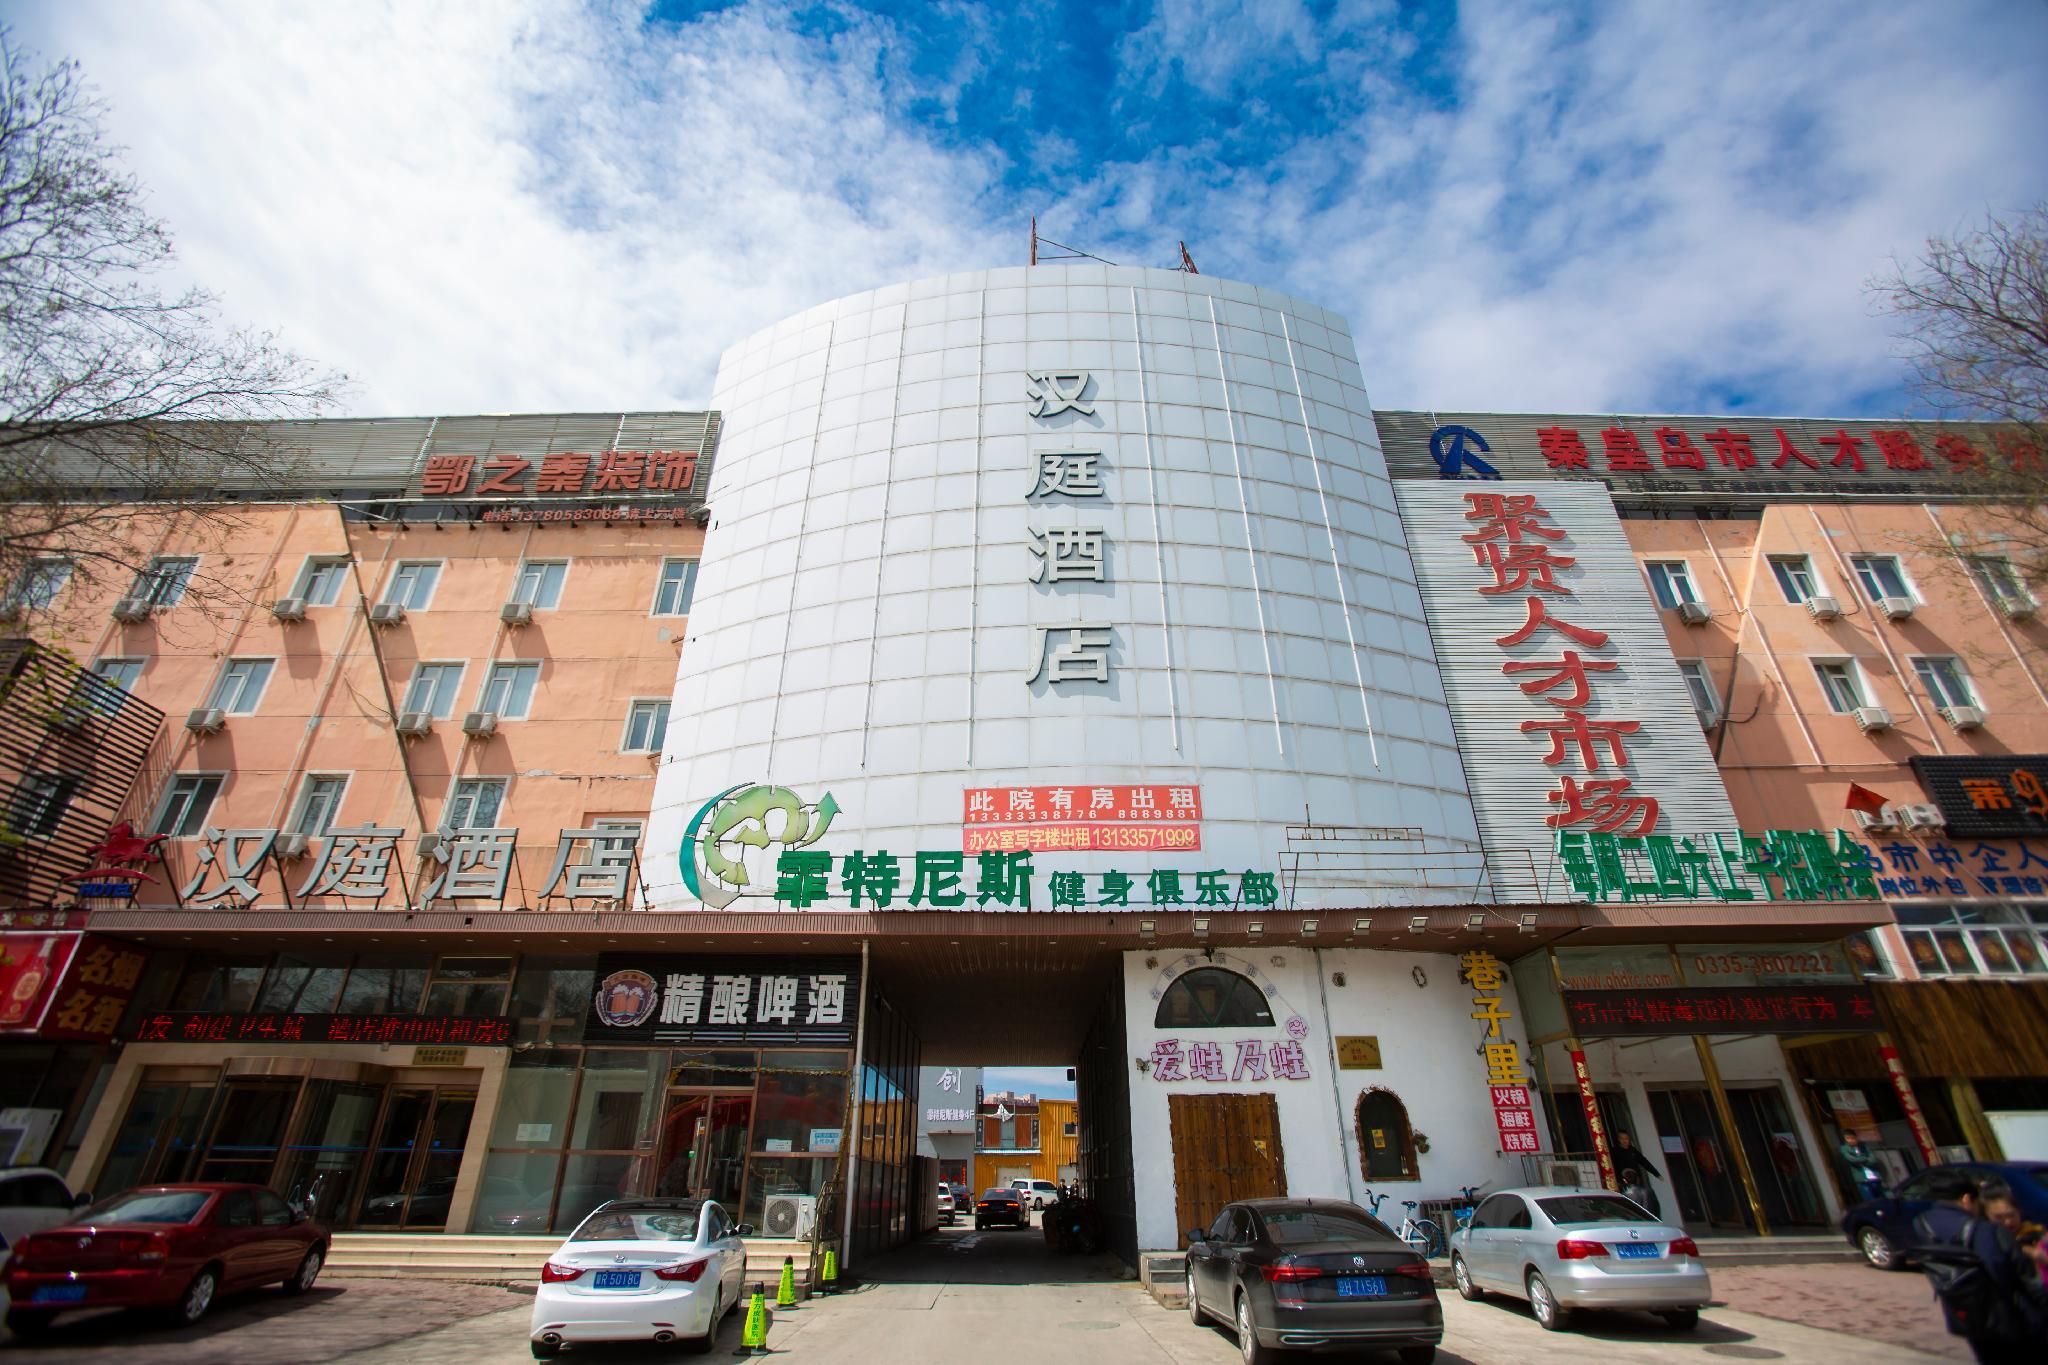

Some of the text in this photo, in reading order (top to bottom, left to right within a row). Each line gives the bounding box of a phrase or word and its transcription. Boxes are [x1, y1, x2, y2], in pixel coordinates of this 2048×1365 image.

[419, 450, 700, 495] 鄂之秦装饰
[1025, 369, 1112, 685] 汉庭酒店
[1460, 492, 1660, 836] 聚贤人才市场
[969, 787, 1197, 811] 此院有房出租
[969, 809, 1197, 822] 13333338776 8889881
[969, 827, 1196, 851] 办公室写字楼出租 13133571999
[180, 822, 641, 901] 汉庭酒店
[79, 883, 134, 897] HOTEL
[774, 849, 1279, 908] 霏特尼斯 健身俱乐部
[1695, 954, 1835, 975] 0335-3602222
[659, 973, 847, 1025] 精酿啤酒
[1461, 950, 1530, 1085] 巷子里
[1151, 1039, 1310, 1082] 爱蛙及蛙
[936, 1068, 963, 1094] 创
[1494, 1088, 1526, 1105] 火锅
[1499, 1111, 1531, 1127] 海鲜
[1504, 1132, 1536, 1149] 烧烤
